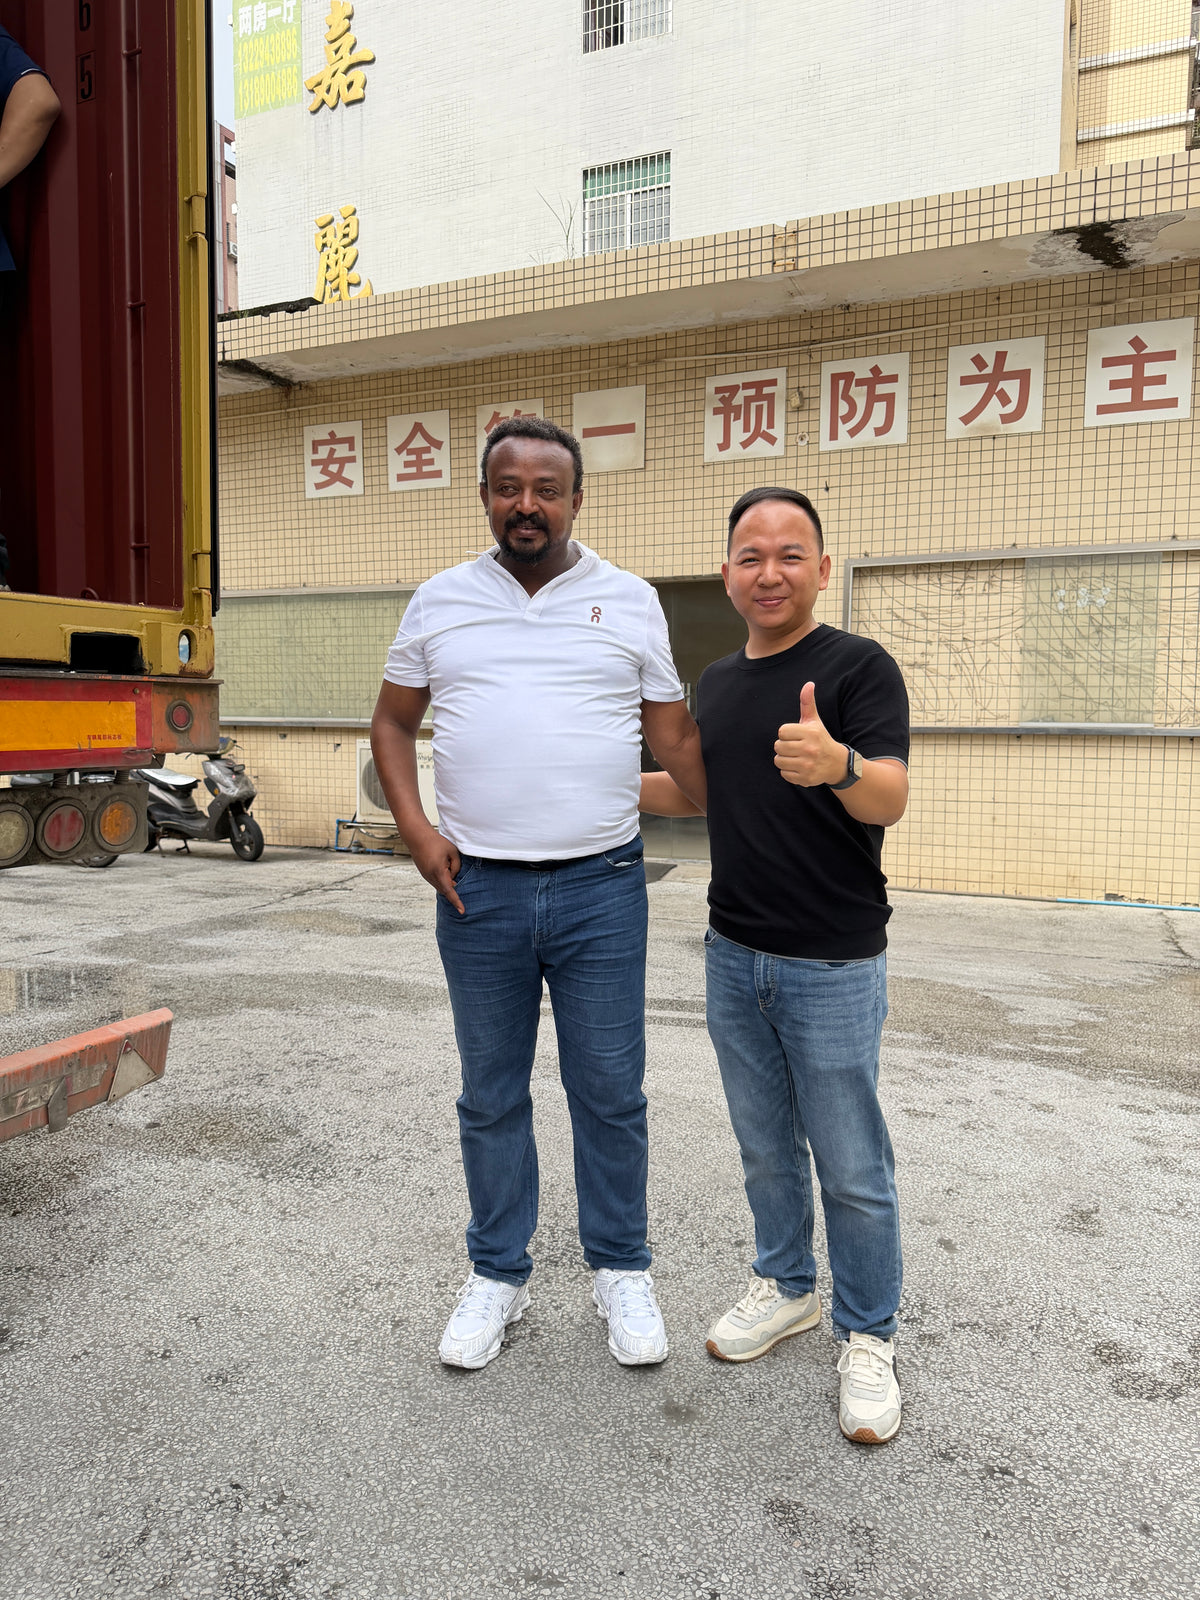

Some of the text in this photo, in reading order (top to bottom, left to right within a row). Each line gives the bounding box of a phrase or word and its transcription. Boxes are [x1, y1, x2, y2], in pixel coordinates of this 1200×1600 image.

[238, 0, 297, 38] 两房一厅
[80, 54, 92, 99] 5
